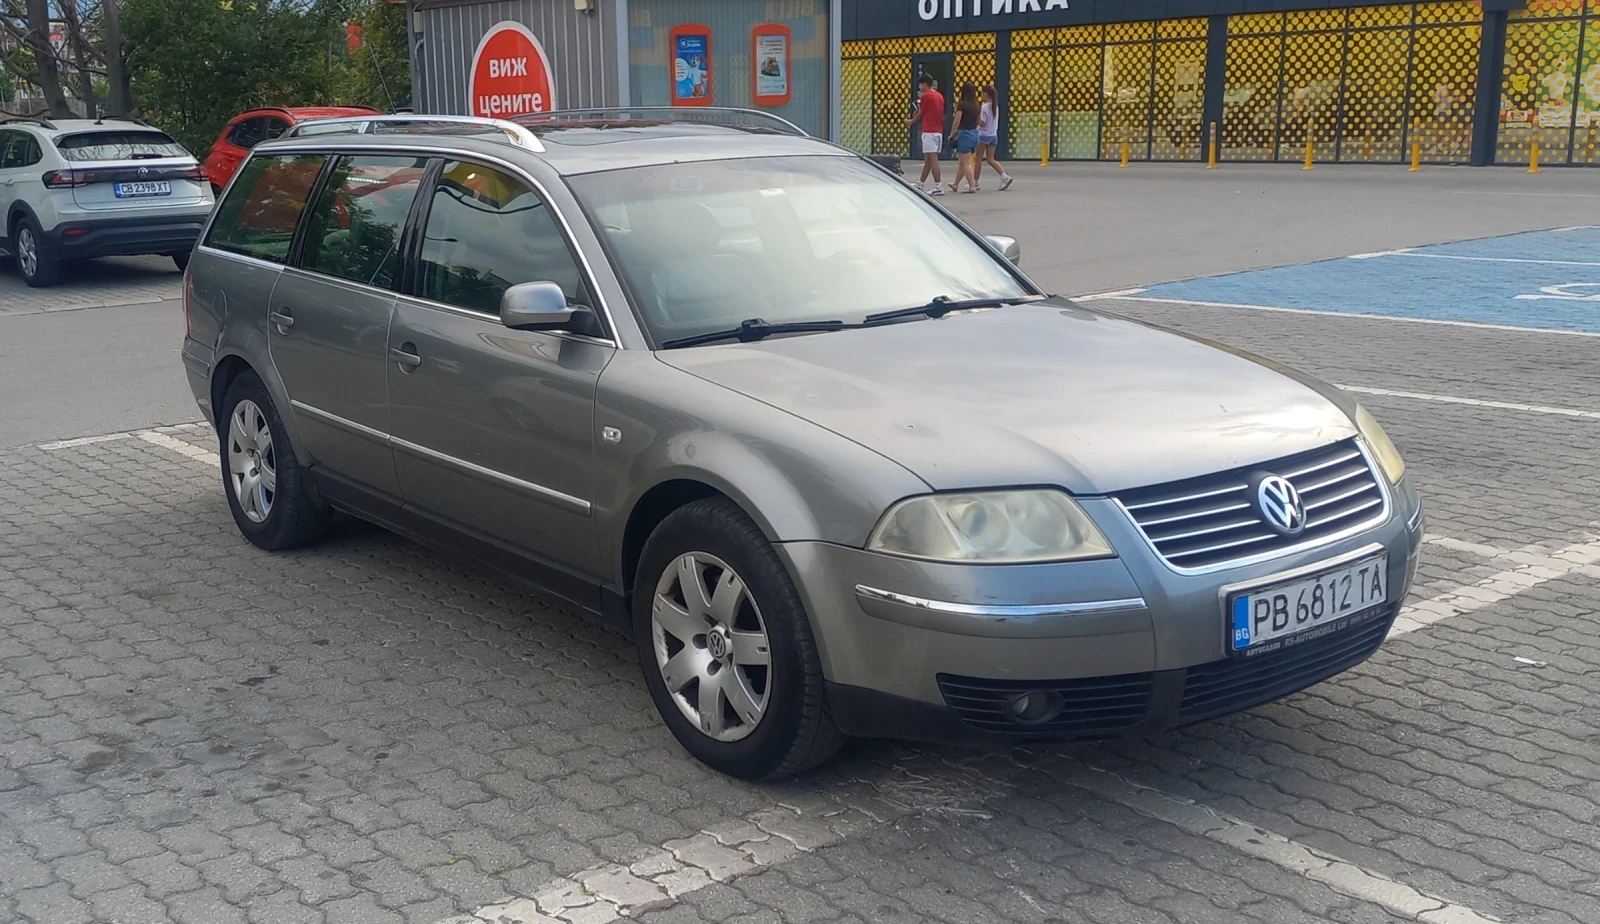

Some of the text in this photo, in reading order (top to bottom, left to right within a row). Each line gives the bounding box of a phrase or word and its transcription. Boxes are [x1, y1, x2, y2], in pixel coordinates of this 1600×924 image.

[489, 57, 528, 78] виж
[479, 93, 543, 118] цените
[121, 182, 168, 193] CB 2398 XT
[1254, 563, 1383, 637] PB 6812 TA
[1235, 628, 1249, 641] BG
